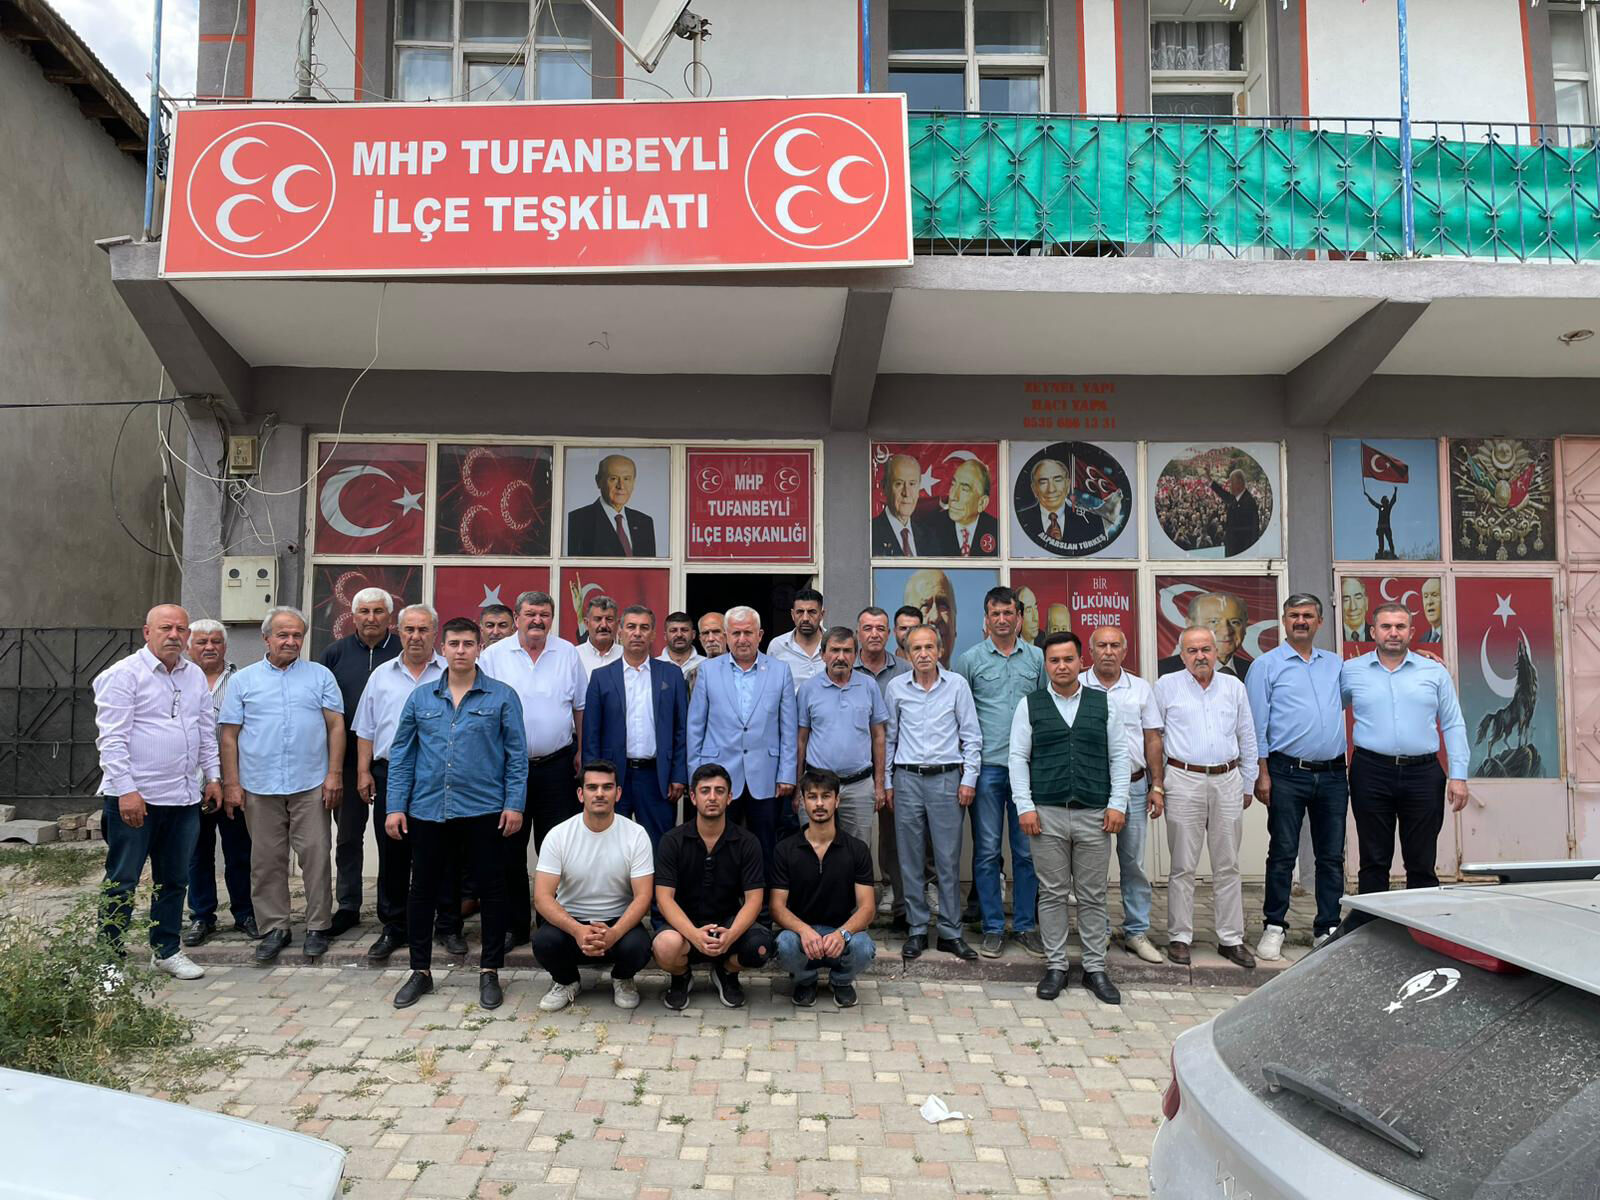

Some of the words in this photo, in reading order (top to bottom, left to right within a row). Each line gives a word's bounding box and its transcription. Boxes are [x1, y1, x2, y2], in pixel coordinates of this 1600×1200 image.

[352, 140, 447, 176] MHP
[461, 127, 729, 175] TUFANBEYLİ
[372, 189, 470, 242] İLÇE
[484, 186, 708, 241] TEŞKİLATI
[735, 474, 764, 490] MHP
[708, 496, 790, 517] TUFANBEYLİ
[692, 522, 722, 547] İLÇE
[725, 522, 807, 547] BAŞKANLIĞI
[1037, 531, 1078, 550] ALPARSLAN
[1093, 576, 1108, 590] BİR
[1071, 592, 1129, 612] ÜLKÜNÜN
[1081, 611, 1121, 629] PEŞİNDE
